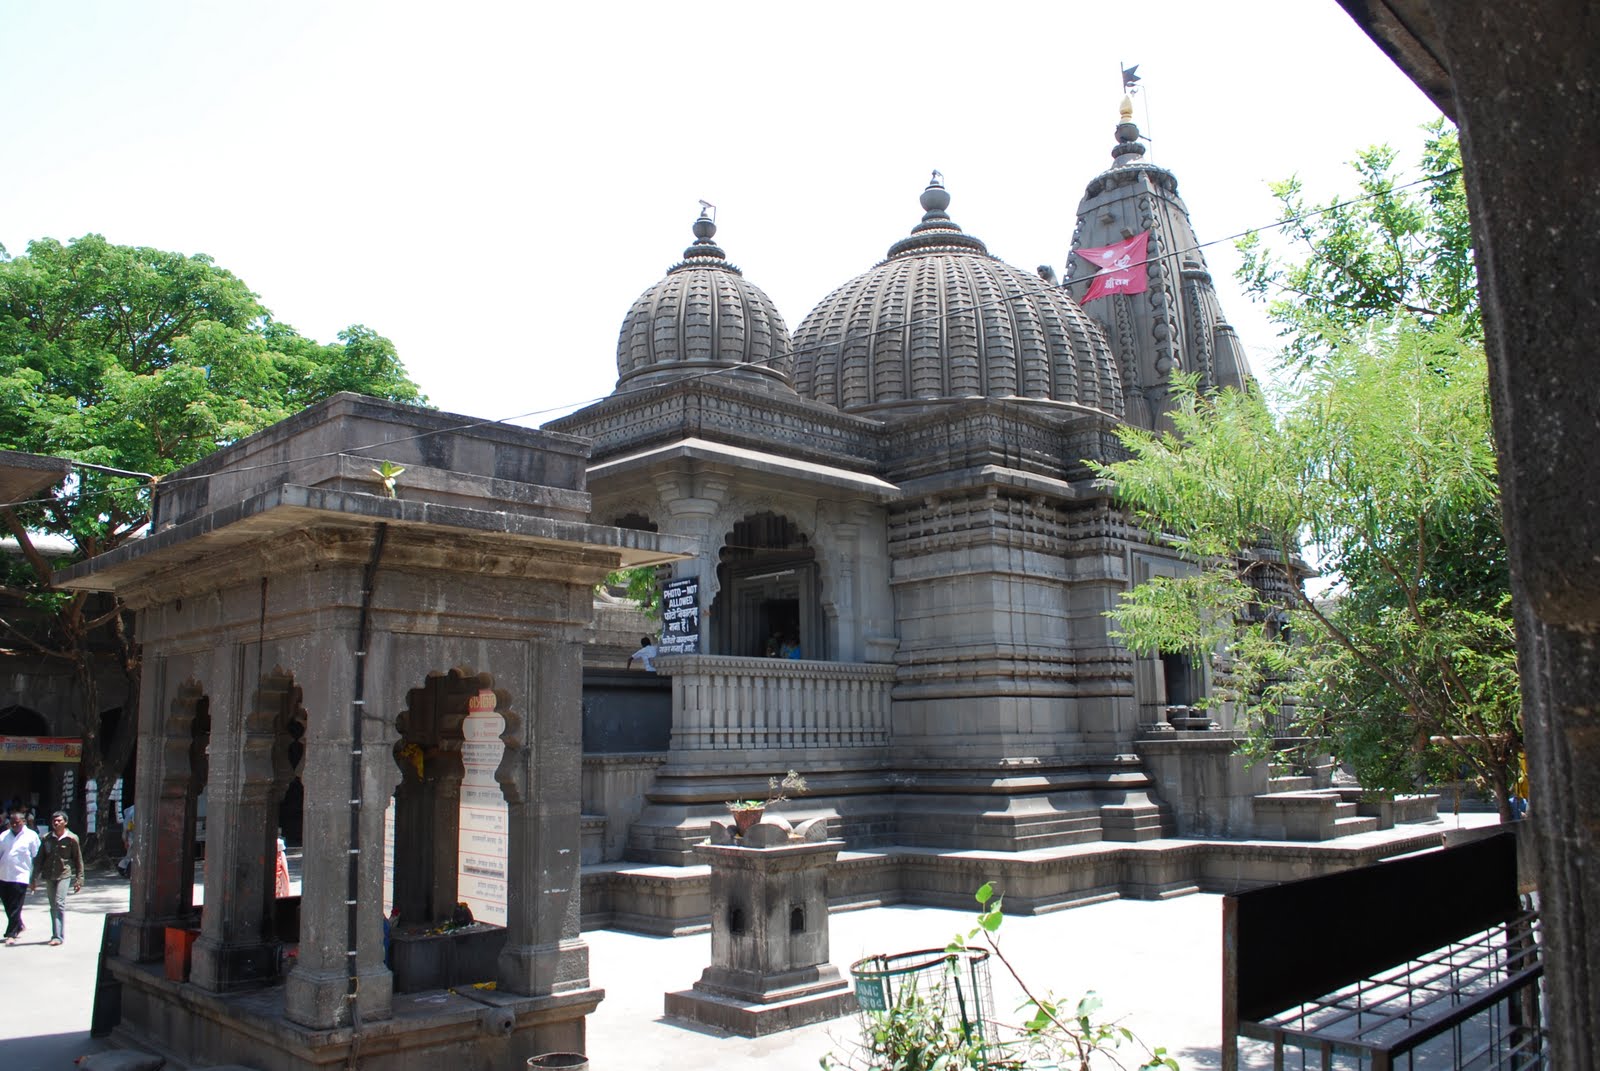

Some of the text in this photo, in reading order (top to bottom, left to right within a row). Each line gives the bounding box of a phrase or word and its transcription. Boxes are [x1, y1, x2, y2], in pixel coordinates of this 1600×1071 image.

[664, 588, 681, 599] PHOTO
[686, 584, 698, 595] NOT
[669, 596, 694, 608] ALLOWED
